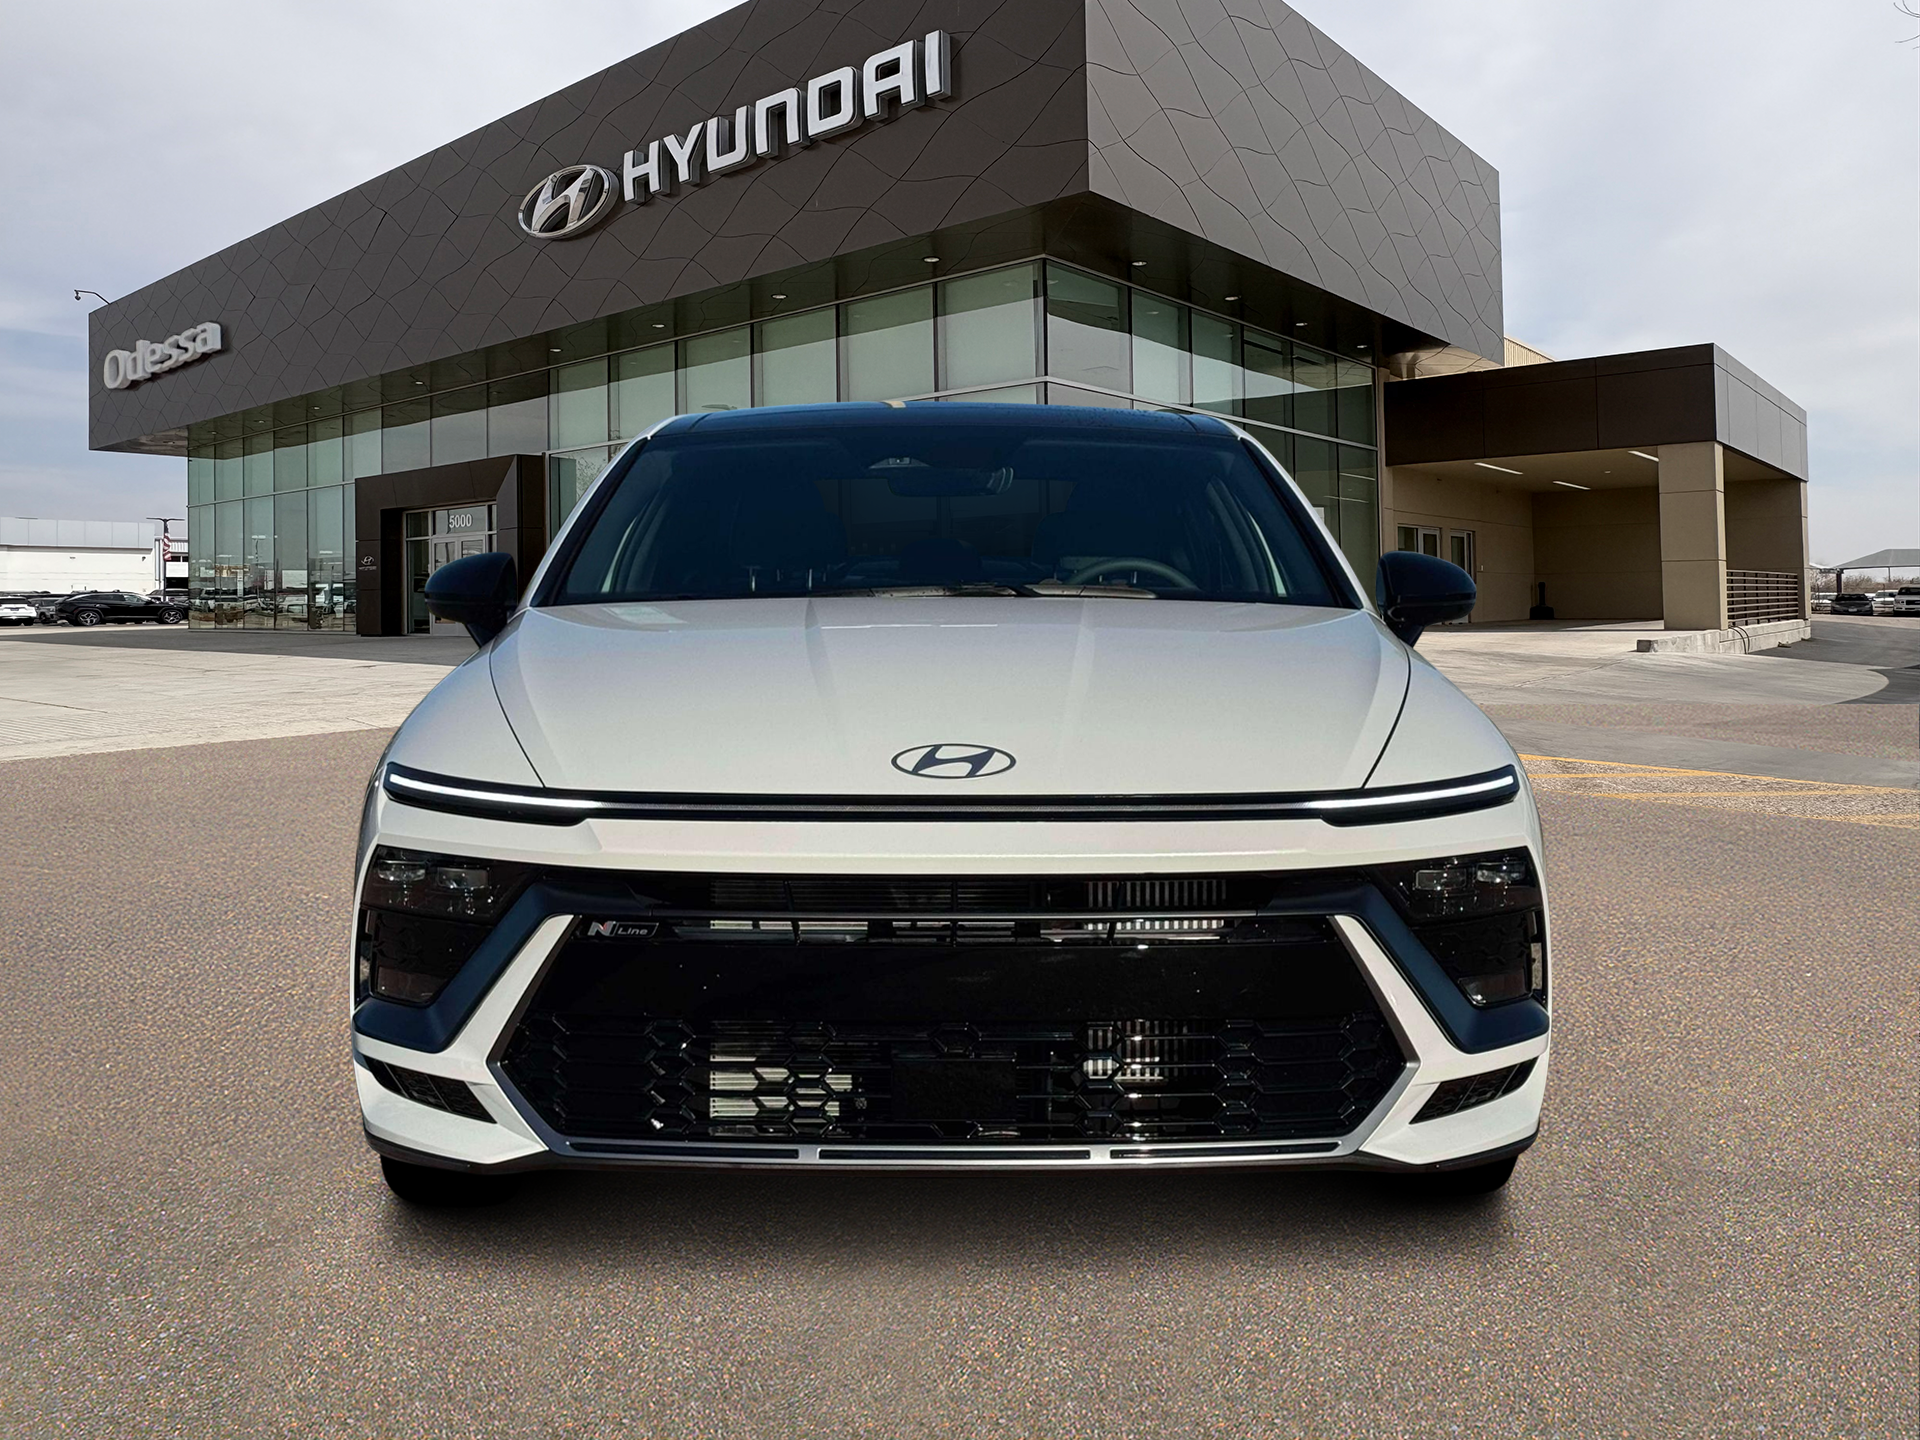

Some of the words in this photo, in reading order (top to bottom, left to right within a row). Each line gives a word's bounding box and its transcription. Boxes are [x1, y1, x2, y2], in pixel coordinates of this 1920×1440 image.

[623, 29, 951, 204] HYUNDAI
[103, 321, 221, 389] Odessa
[449, 513, 472, 528] 5000
[587, 921, 615, 936] N
[617, 927, 648, 935] Line
